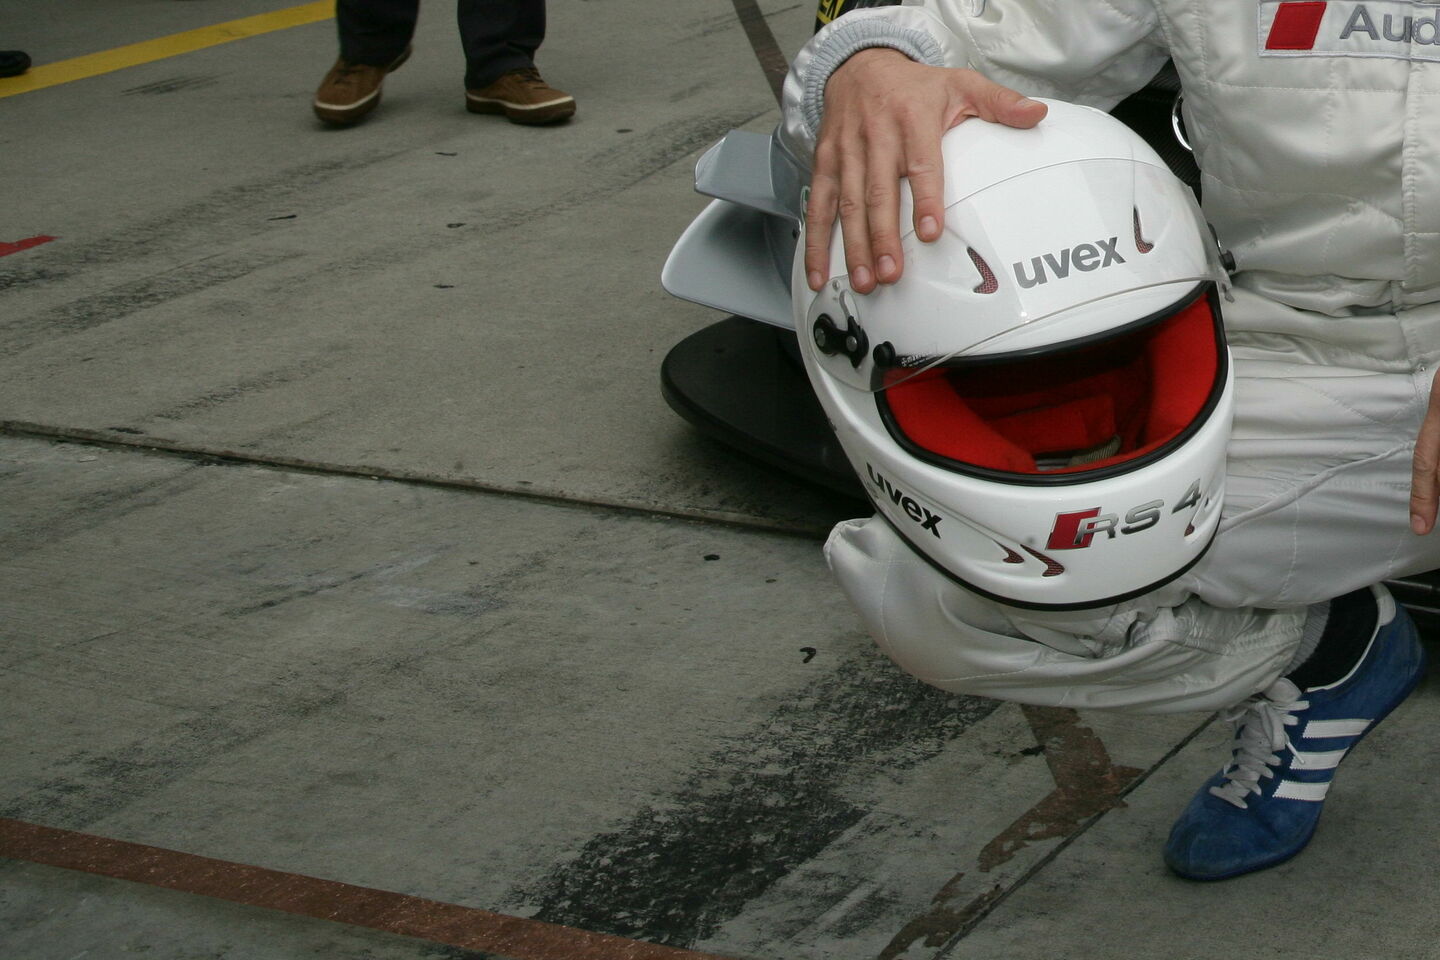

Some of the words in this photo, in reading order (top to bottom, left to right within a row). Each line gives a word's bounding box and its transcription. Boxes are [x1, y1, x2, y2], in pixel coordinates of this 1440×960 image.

[1012, 237, 1126, 289] uvex
[866, 462, 943, 539] uvex
[1073, 499, 1164, 545] RS
[1171, 478, 1202, 514] 4
